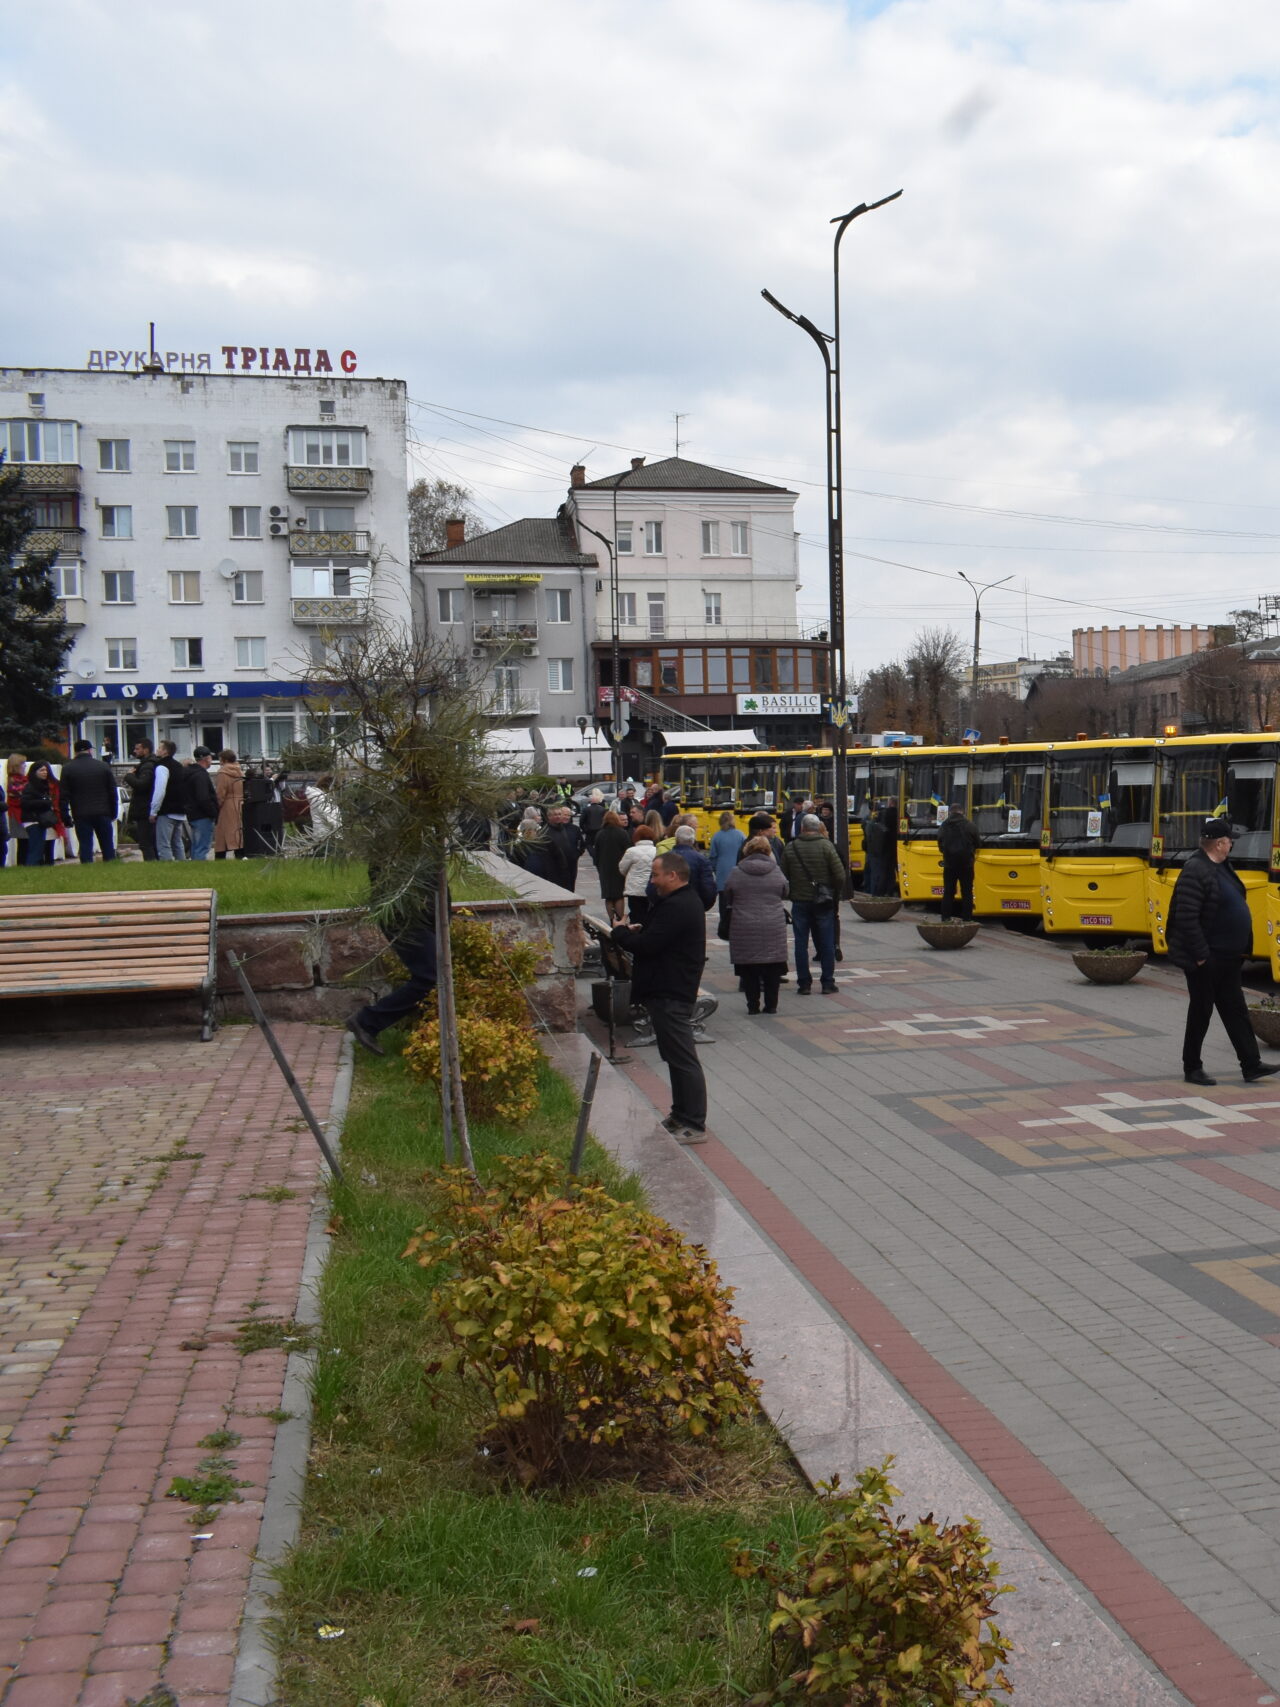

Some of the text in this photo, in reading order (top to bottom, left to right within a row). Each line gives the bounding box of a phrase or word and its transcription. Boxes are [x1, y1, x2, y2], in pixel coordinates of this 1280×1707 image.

[88, 346, 357, 375] ДРУКАРНЯ ТРІАДА С
[762, 696, 818, 706] BASILIC
